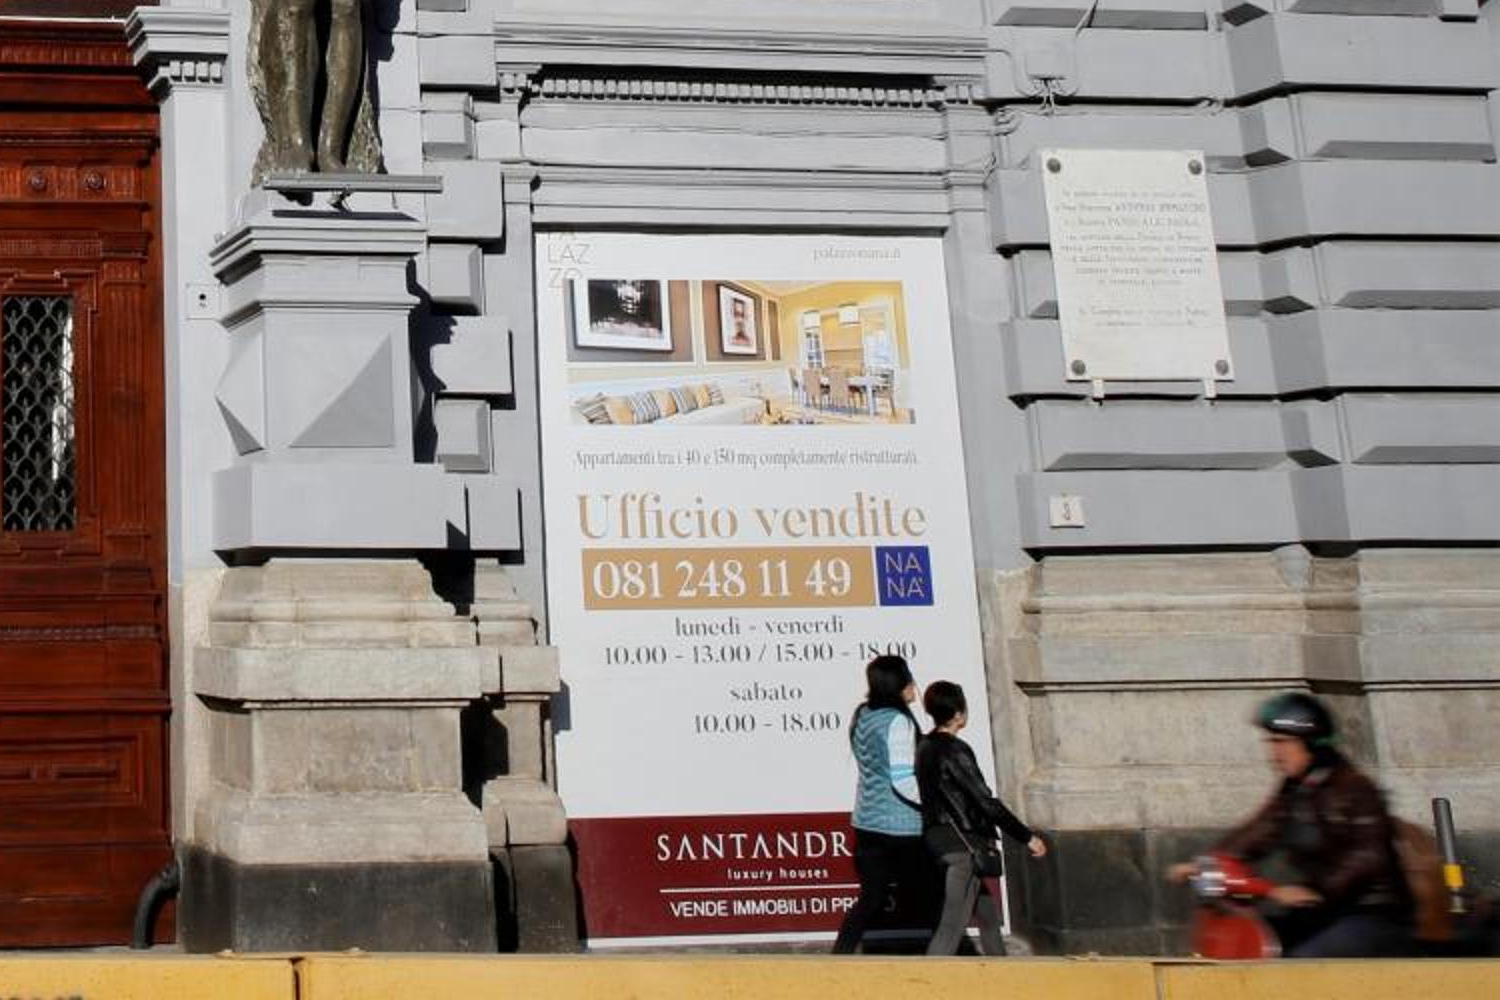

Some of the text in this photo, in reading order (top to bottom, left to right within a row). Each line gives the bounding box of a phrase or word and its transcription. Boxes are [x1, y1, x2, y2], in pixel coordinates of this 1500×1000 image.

[548, 243, 591, 265] LAZ
[576, 450, 655, 470] Appartamenti
[685, 449, 701, 466] 40
[737, 453, 757, 471] mq
[759, 449, 844, 470] completamente
[577, 490, 927, 539] Ufficio vendite
[884, 551, 922, 574] NA
[592, 557, 853, 599] 081 248 11 49
[604, 646, 668, 666] 10.00
[693, 645, 752, 665] 13.00
[758, 643, 768, 664] /
[776, 642, 834, 664] 15.00
[858, 641, 917, 661] 1800
[729, 682, 804, 702] sabato
[694, 712, 756, 734] 10.00
[781, 711, 841, 733] 18.00
[656, 831, 853, 861] SANTANDR
[727, 865, 829, 882] luxury houses
[670, 899, 729, 918] VENDE
[733, 899, 807, 916] IMMOBILI
[810, 897, 828, 914] DI
